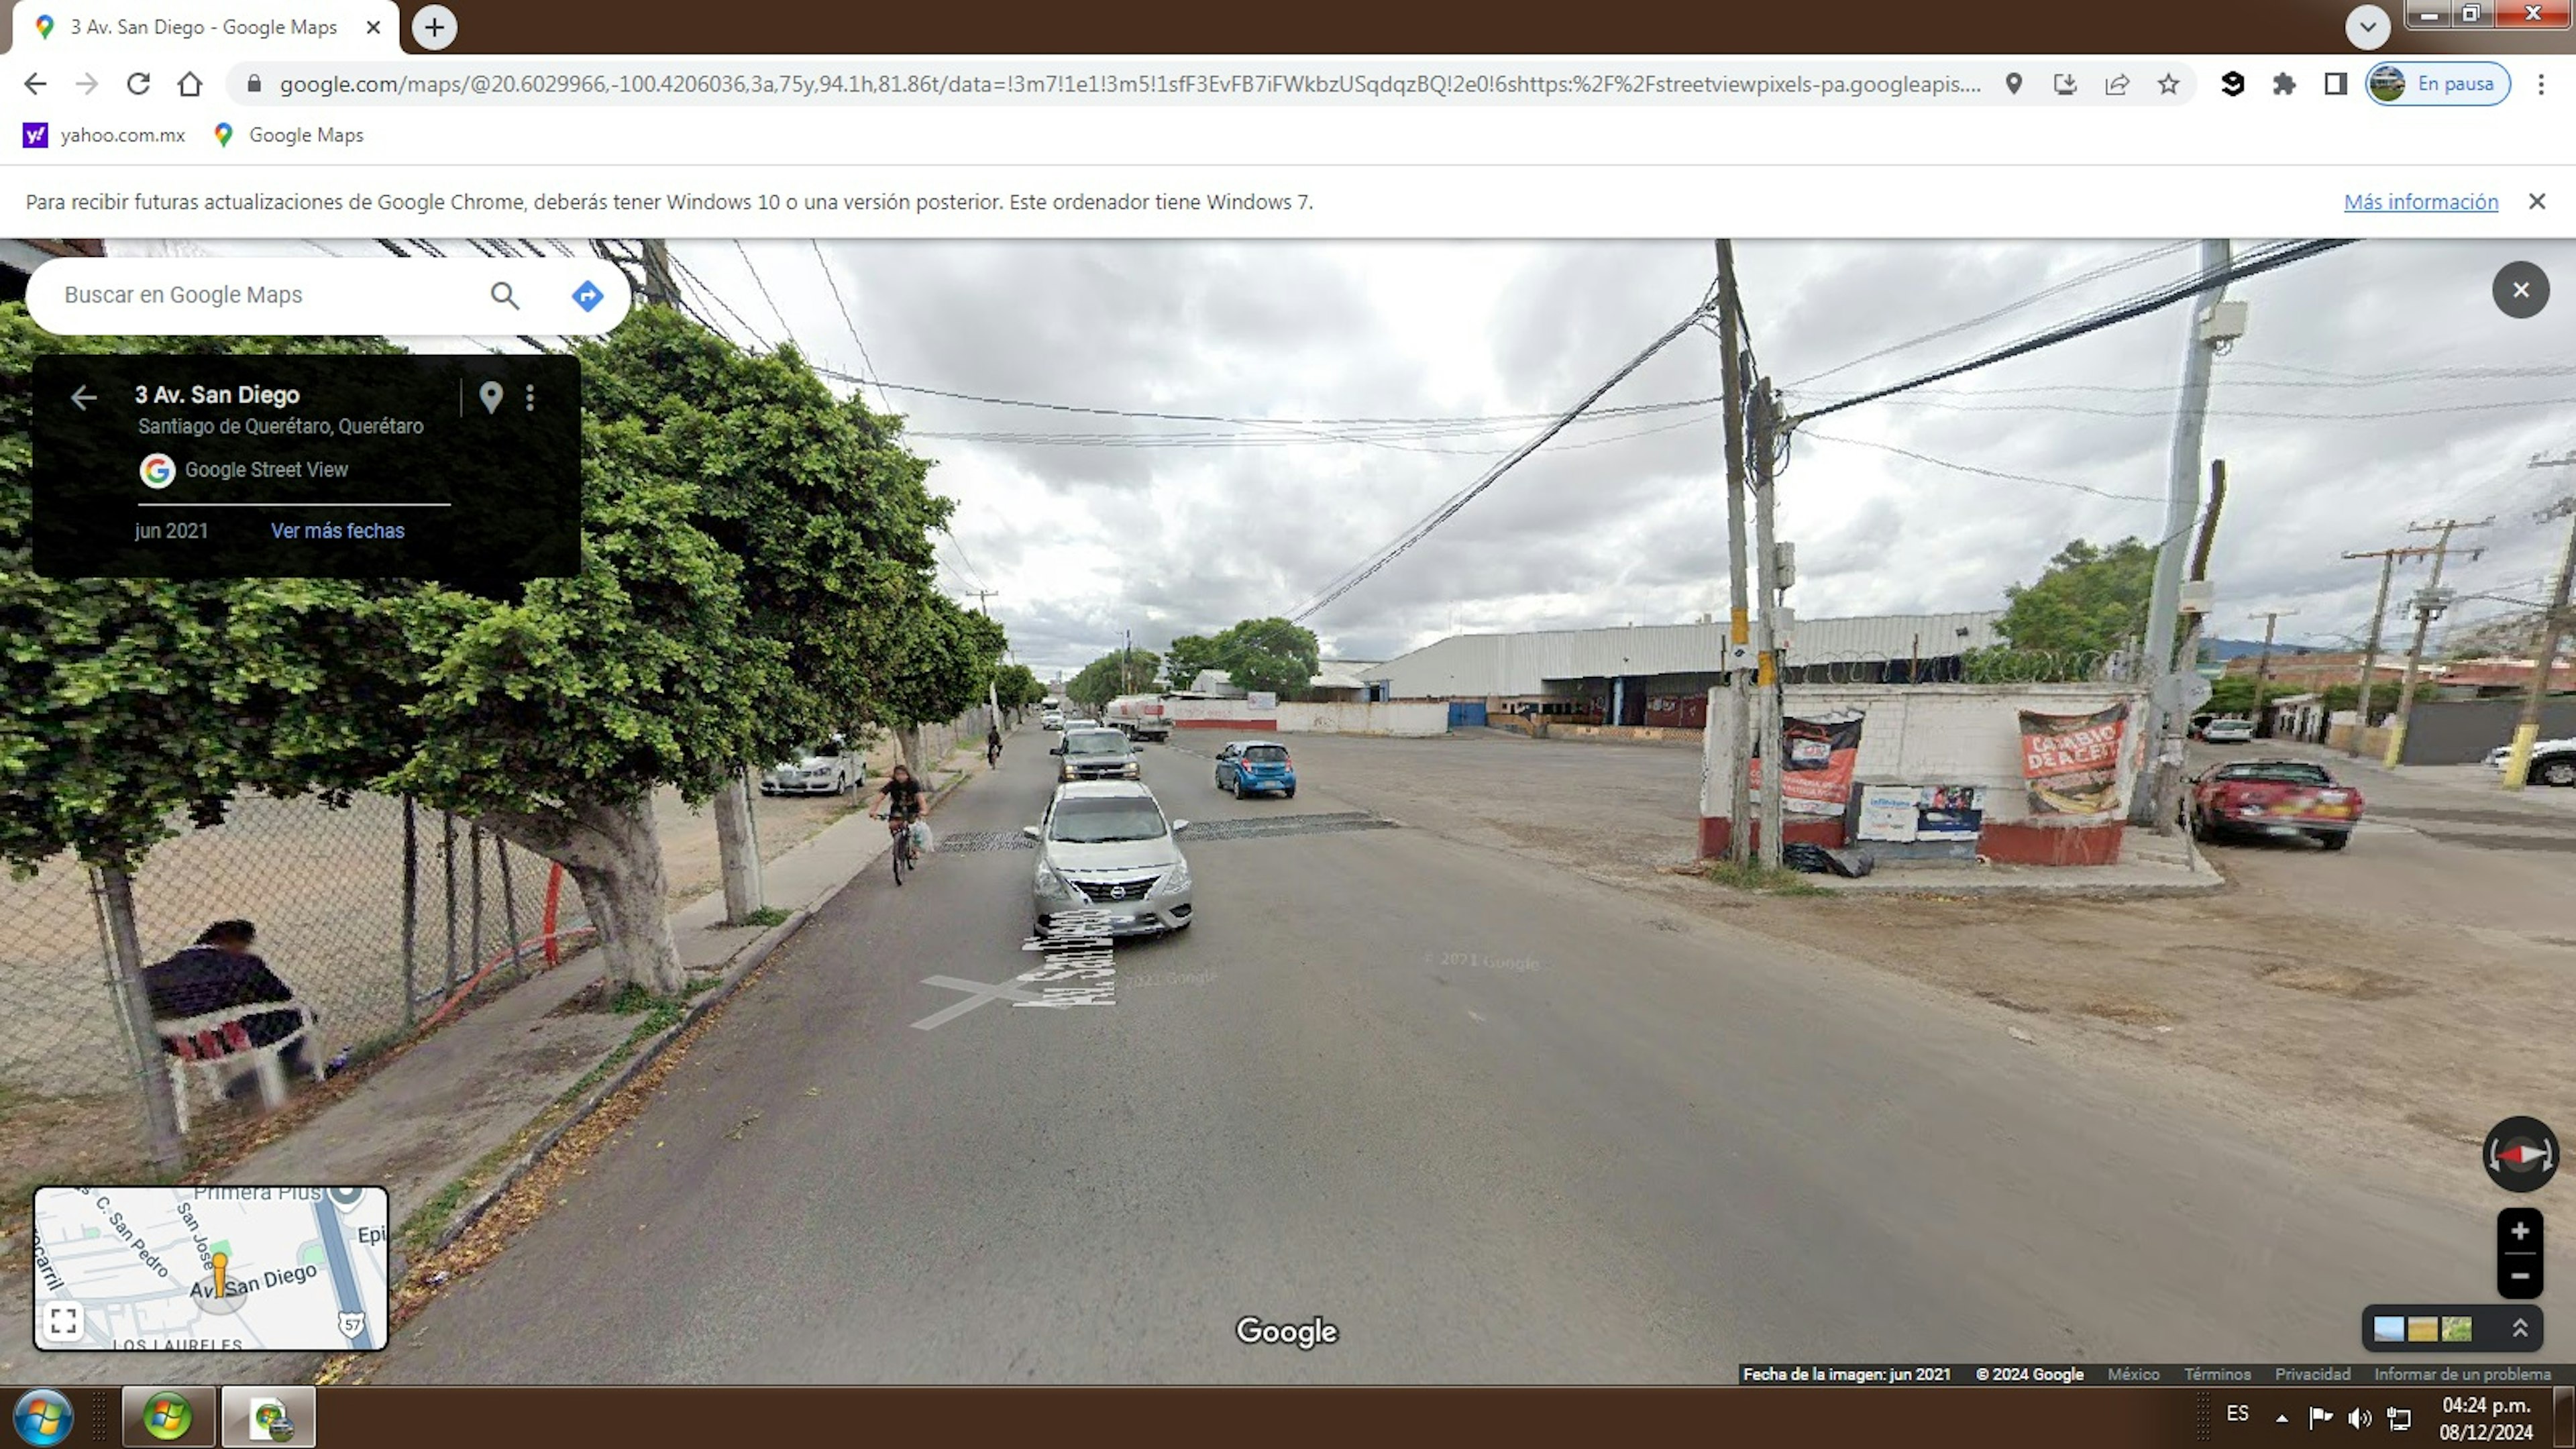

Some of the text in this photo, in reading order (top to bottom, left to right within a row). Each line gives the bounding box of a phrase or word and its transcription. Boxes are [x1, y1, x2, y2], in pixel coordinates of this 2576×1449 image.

[71, 19, 81, 35] 3
[87, 19, 112, 34] Av.
[118, 19, 148, 35] San
[155, 19, 205, 40] Diego
[223, 19, 286, 40] Google
[291, 19, 337, 39] Maps
[2419, 74, 2494, 95] En pausa
[60, 127, 185, 148] yahoo.com.mx
[250, 126, 364, 148] Google Maps
[27, 193, 1313, 215] Para recibir futuras actualizaciones de Google Chrome, deberás tener Windows 10 o una versión posterior. Este ordenador tiene Windows 7.
[2345, 193, 2499, 210] Más información
[65, 284, 303, 309] Buscar en Google Maps
[135, 384, 301, 409] 3 Av. San Diego
[138, 416, 425, 437] Santiago de Querétaro, Querétaro
[185, 461, 349, 481] Google Street View
[134, 522, 207, 542] jun 2021
[271, 521, 405, 539] Ver más fechas
[2027, 752, 2057, 769] DE
[177, 1202, 199, 1232] San
[96, 1196, 169, 1278] C. San Pedro
[224, 1279, 260, 1295] San
[264, 1265, 318, 1289] Diego
[345, 1320, 362, 1331] 57
[1743, 1366, 1951, 1384] Fecha de la imagen: jun 2021
[1992, 1367, 2030, 1381] 2024
[2033, 1366, 2084, 1384] Google
[2108, 1364, 2160, 1381] México
[2184, 1366, 2252, 1381] Términos
[2275, 1366, 2351, 1382] Privacidad
[2375, 1364, 2552, 1384] Informar de un problema
[2227, 1404, 2249, 1421] ES
[2443, 1396, 2531, 1417] 04:24 p.m.
[2440, 1424, 2534, 1442] 08/12/2024
